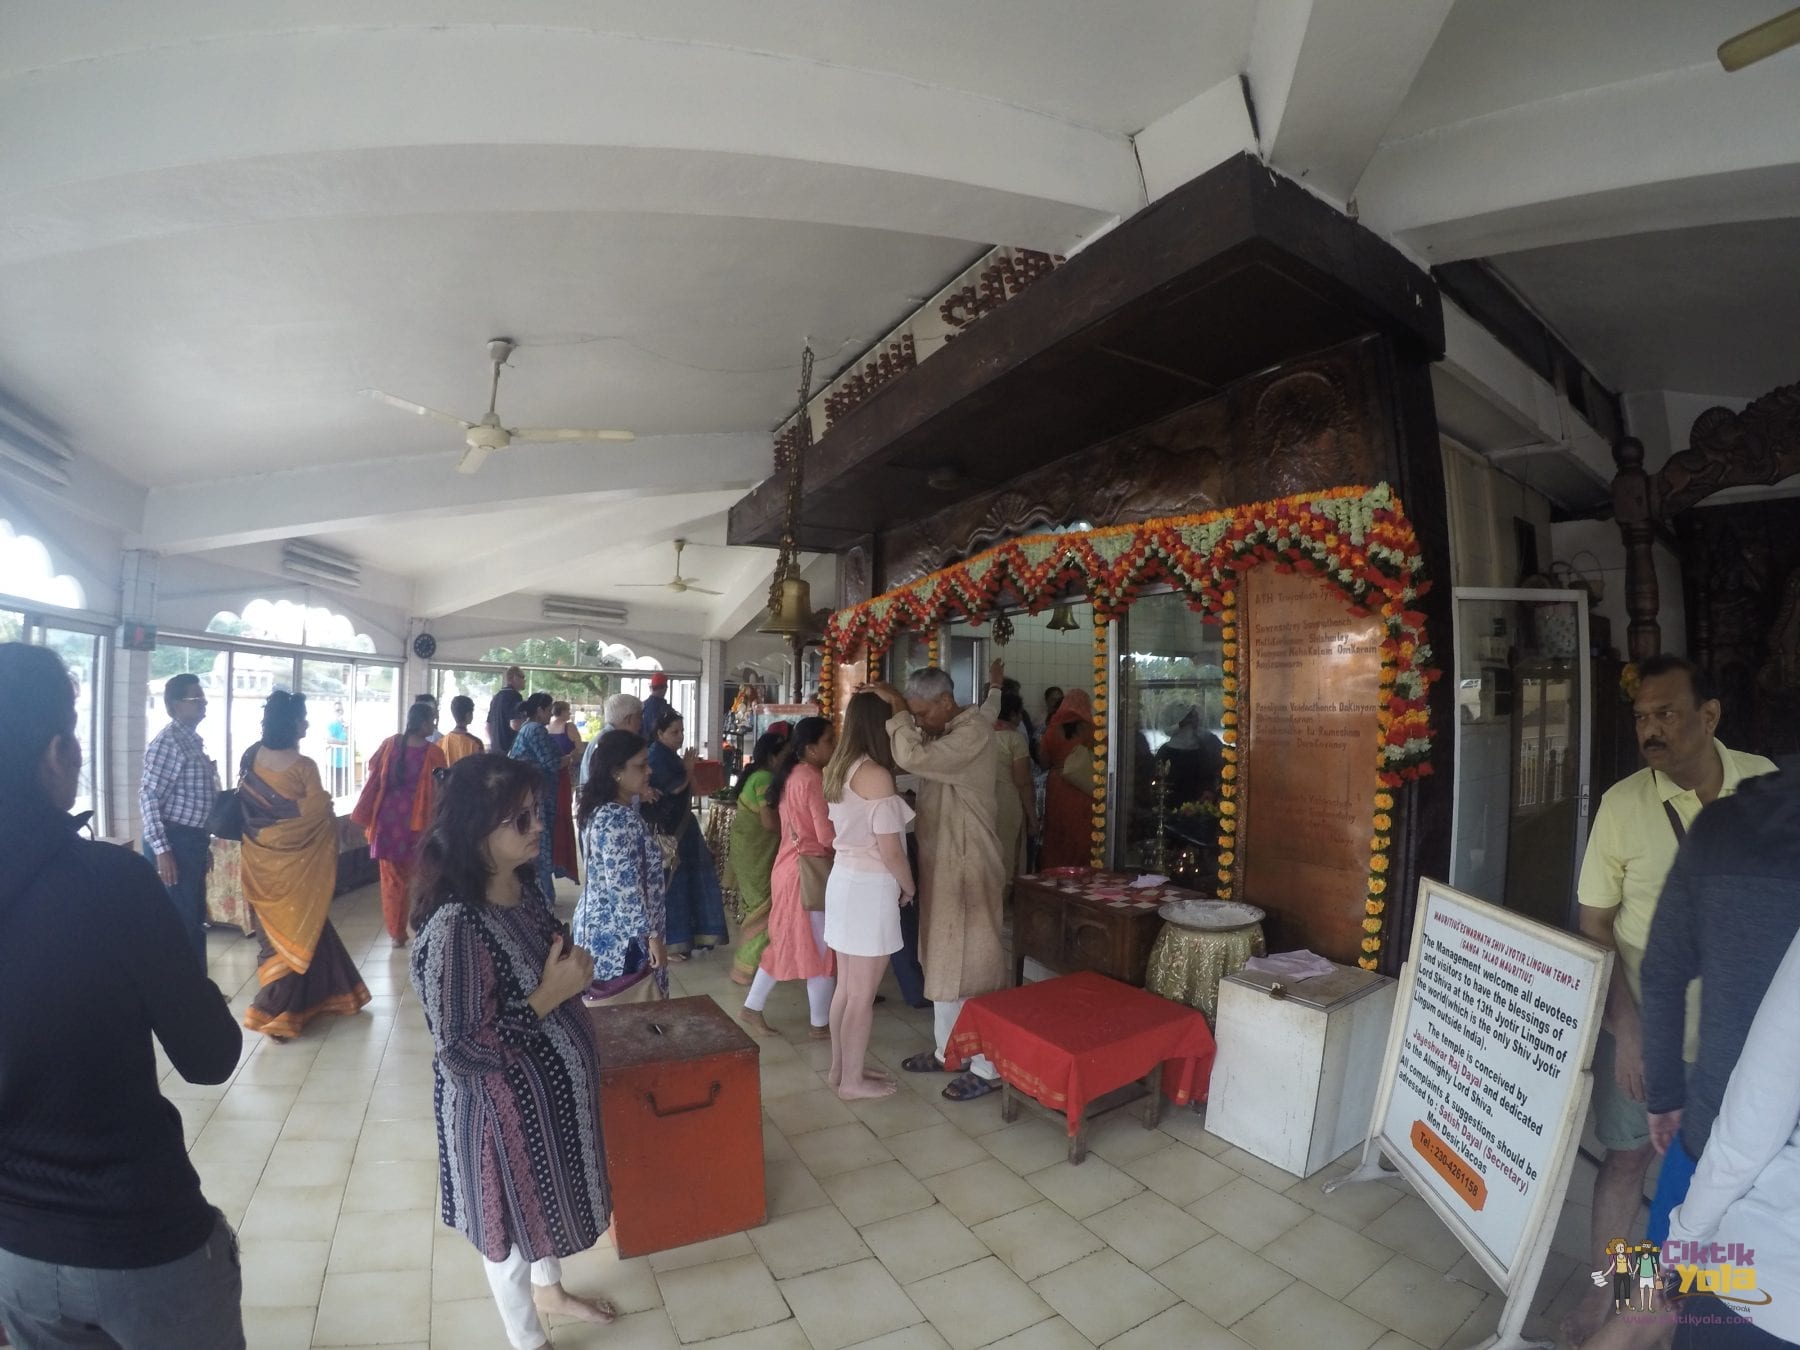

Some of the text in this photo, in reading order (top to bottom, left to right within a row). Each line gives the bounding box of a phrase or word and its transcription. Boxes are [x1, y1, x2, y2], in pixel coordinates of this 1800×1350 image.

[1423, 933, 1578, 1030] The Management welcome all devotees
[1424, 952, 1564, 1042] and visitors to have the blessings of
[1482, 949, 1498, 966] TALAO
[1500, 960, 1534, 986] MAURITIUS)
[1491, 939, 1504, 953] SHIV
[1505, 945, 1525, 965] JYOTIR
[1526, 955, 1551, 976] LINGUM
[1553, 969, 1580, 990] TEMPLE
[1414, 992, 1487, 1050] Lingum outside India).
[1417, 976, 1560, 1079] the world(which is the only Shiv Jyotir
[1418, 963, 1568, 1063] Lord Shiva at the 13th Jyotir Lingum of
[1405, 1038, 1494, 1118] to the Almighty Lord Shiva.
[1413, 1028, 1544, 1136] Jayeshwar Raj Dayal and dedicated
[1428, 1022, 1528, 1106] The temple is conceived by
[1399, 1070, 1426, 1099] adressed
[1427, 1094, 1434, 1106] to
[1438, 1104, 1460, 1132] Satish
[1461, 1122, 1483, 1151] Dayal
[1483, 1144, 1529, 1196] (Secretary)
[1400, 1054, 1538, 1181] All complaints & suggestions should be
[1426, 1110, 1441, 1130] Mon
[1419, 1132, 1430, 1148] Tel
[1434, 1147, 1479, 1197] 230-4261158
